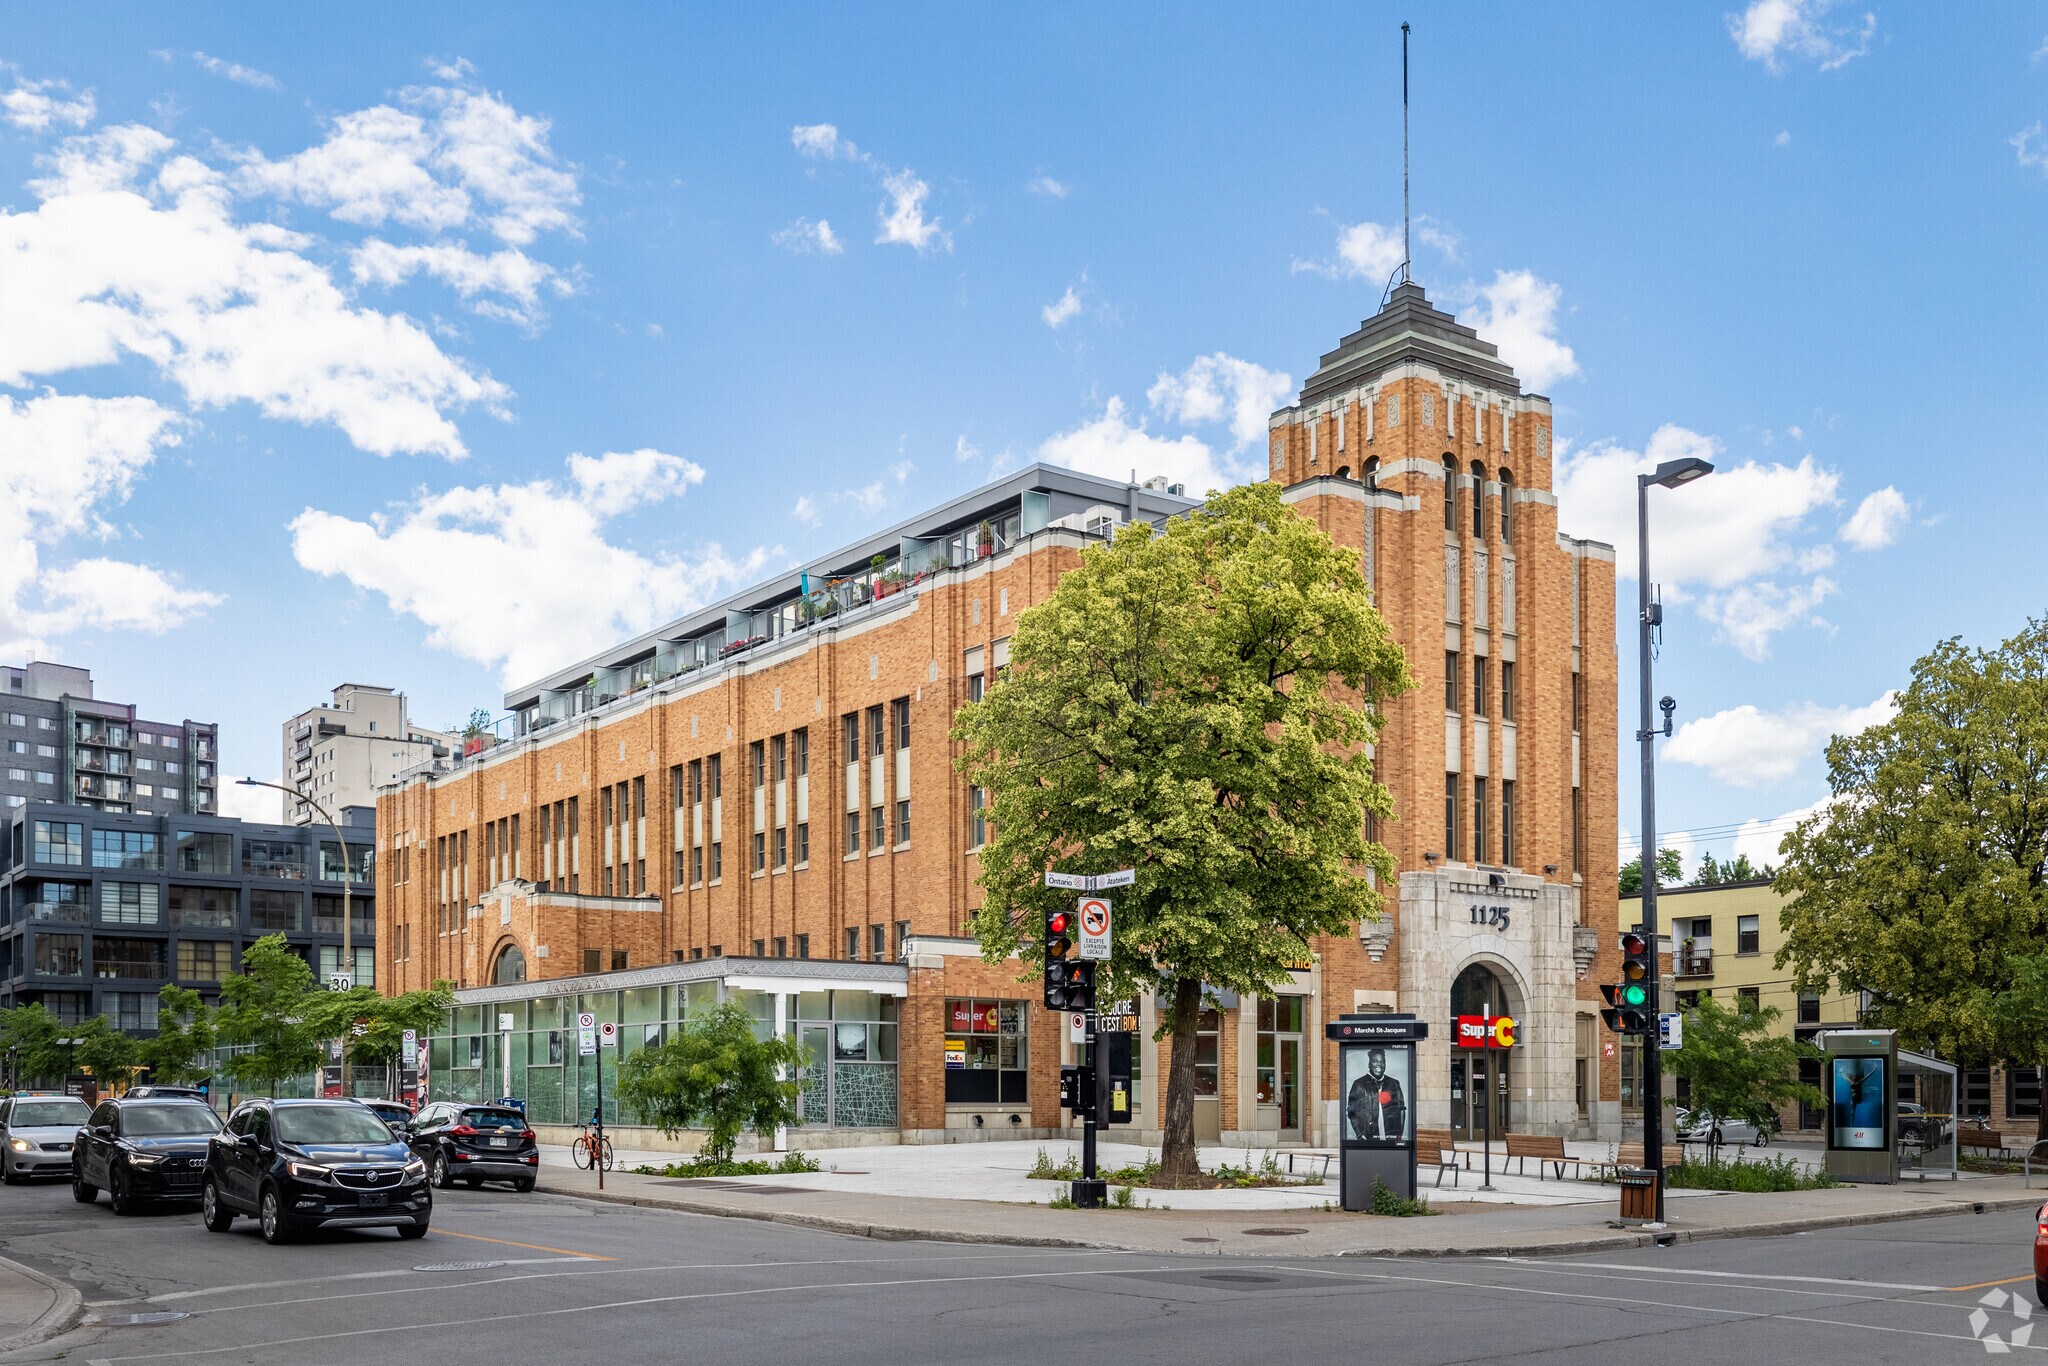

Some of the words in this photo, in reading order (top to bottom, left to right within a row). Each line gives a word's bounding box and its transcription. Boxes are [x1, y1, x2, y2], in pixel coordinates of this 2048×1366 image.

[1048, 877, 1072, 886] Ontario
[1106, 876, 1130, 886] Atateken
[1470, 905, 1510, 932] 1125
[332, 978, 348, 991] 30
[986, 1008, 998, 1026] C
[1102, 1016, 1120, 1032] C'EST
[1123, 1016, 1137, 1031] BON
[1460, 1023, 1496, 1039] Super
[1495, 1018, 1515, 1047] C
